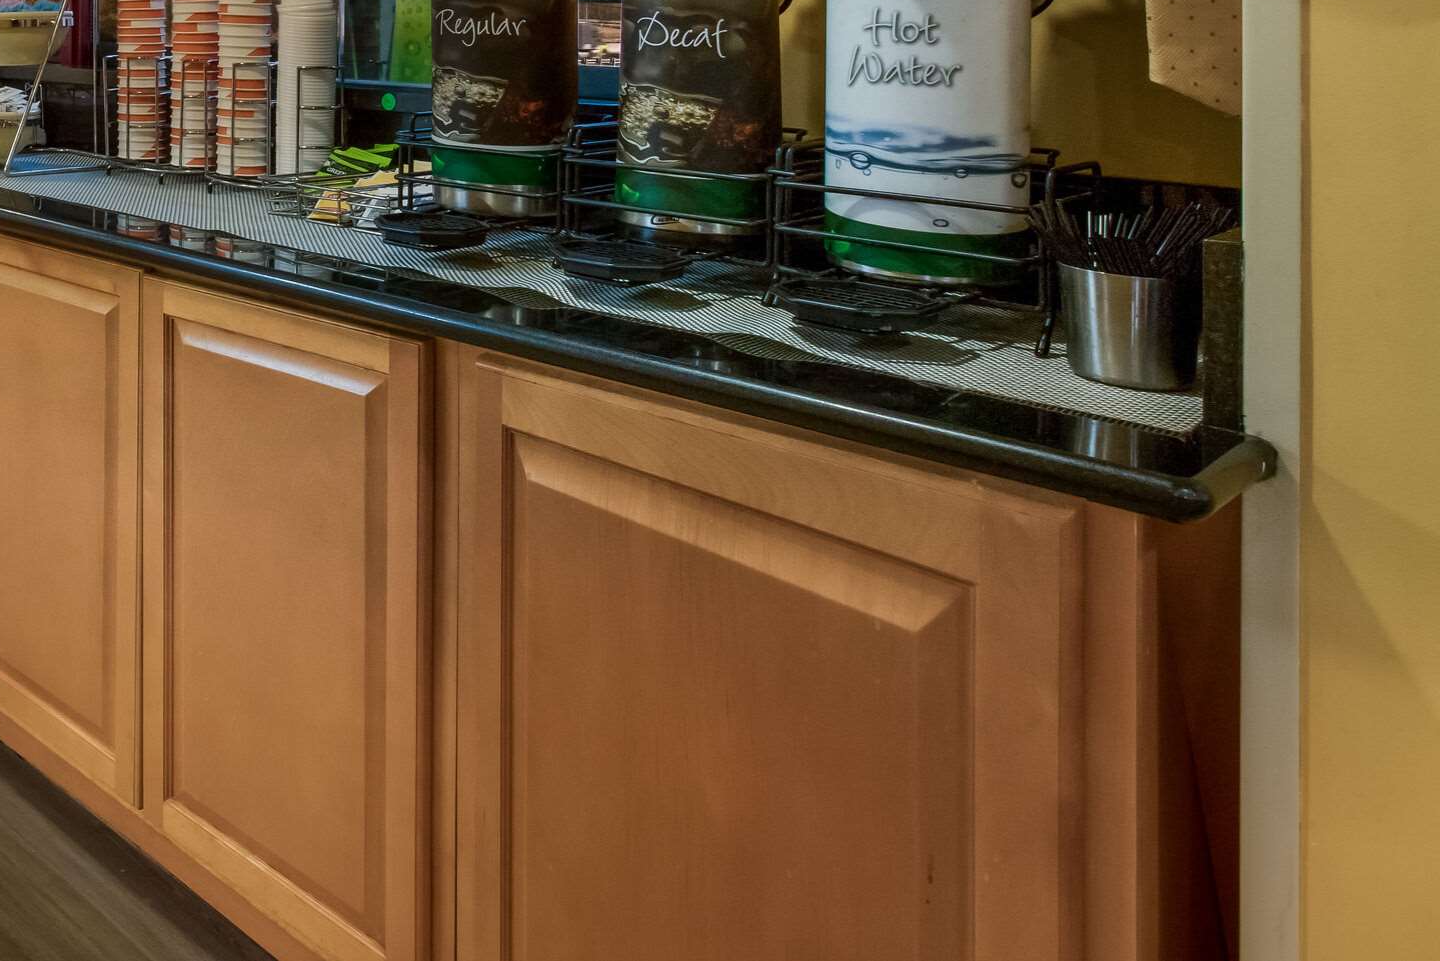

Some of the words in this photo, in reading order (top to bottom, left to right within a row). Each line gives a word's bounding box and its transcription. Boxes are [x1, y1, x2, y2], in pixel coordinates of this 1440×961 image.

[435, 8, 527, 47] Regular
[637, 10, 729, 58] Decaf
[863, 7, 939, 46] Hot
[847, 45, 962, 87] Water
